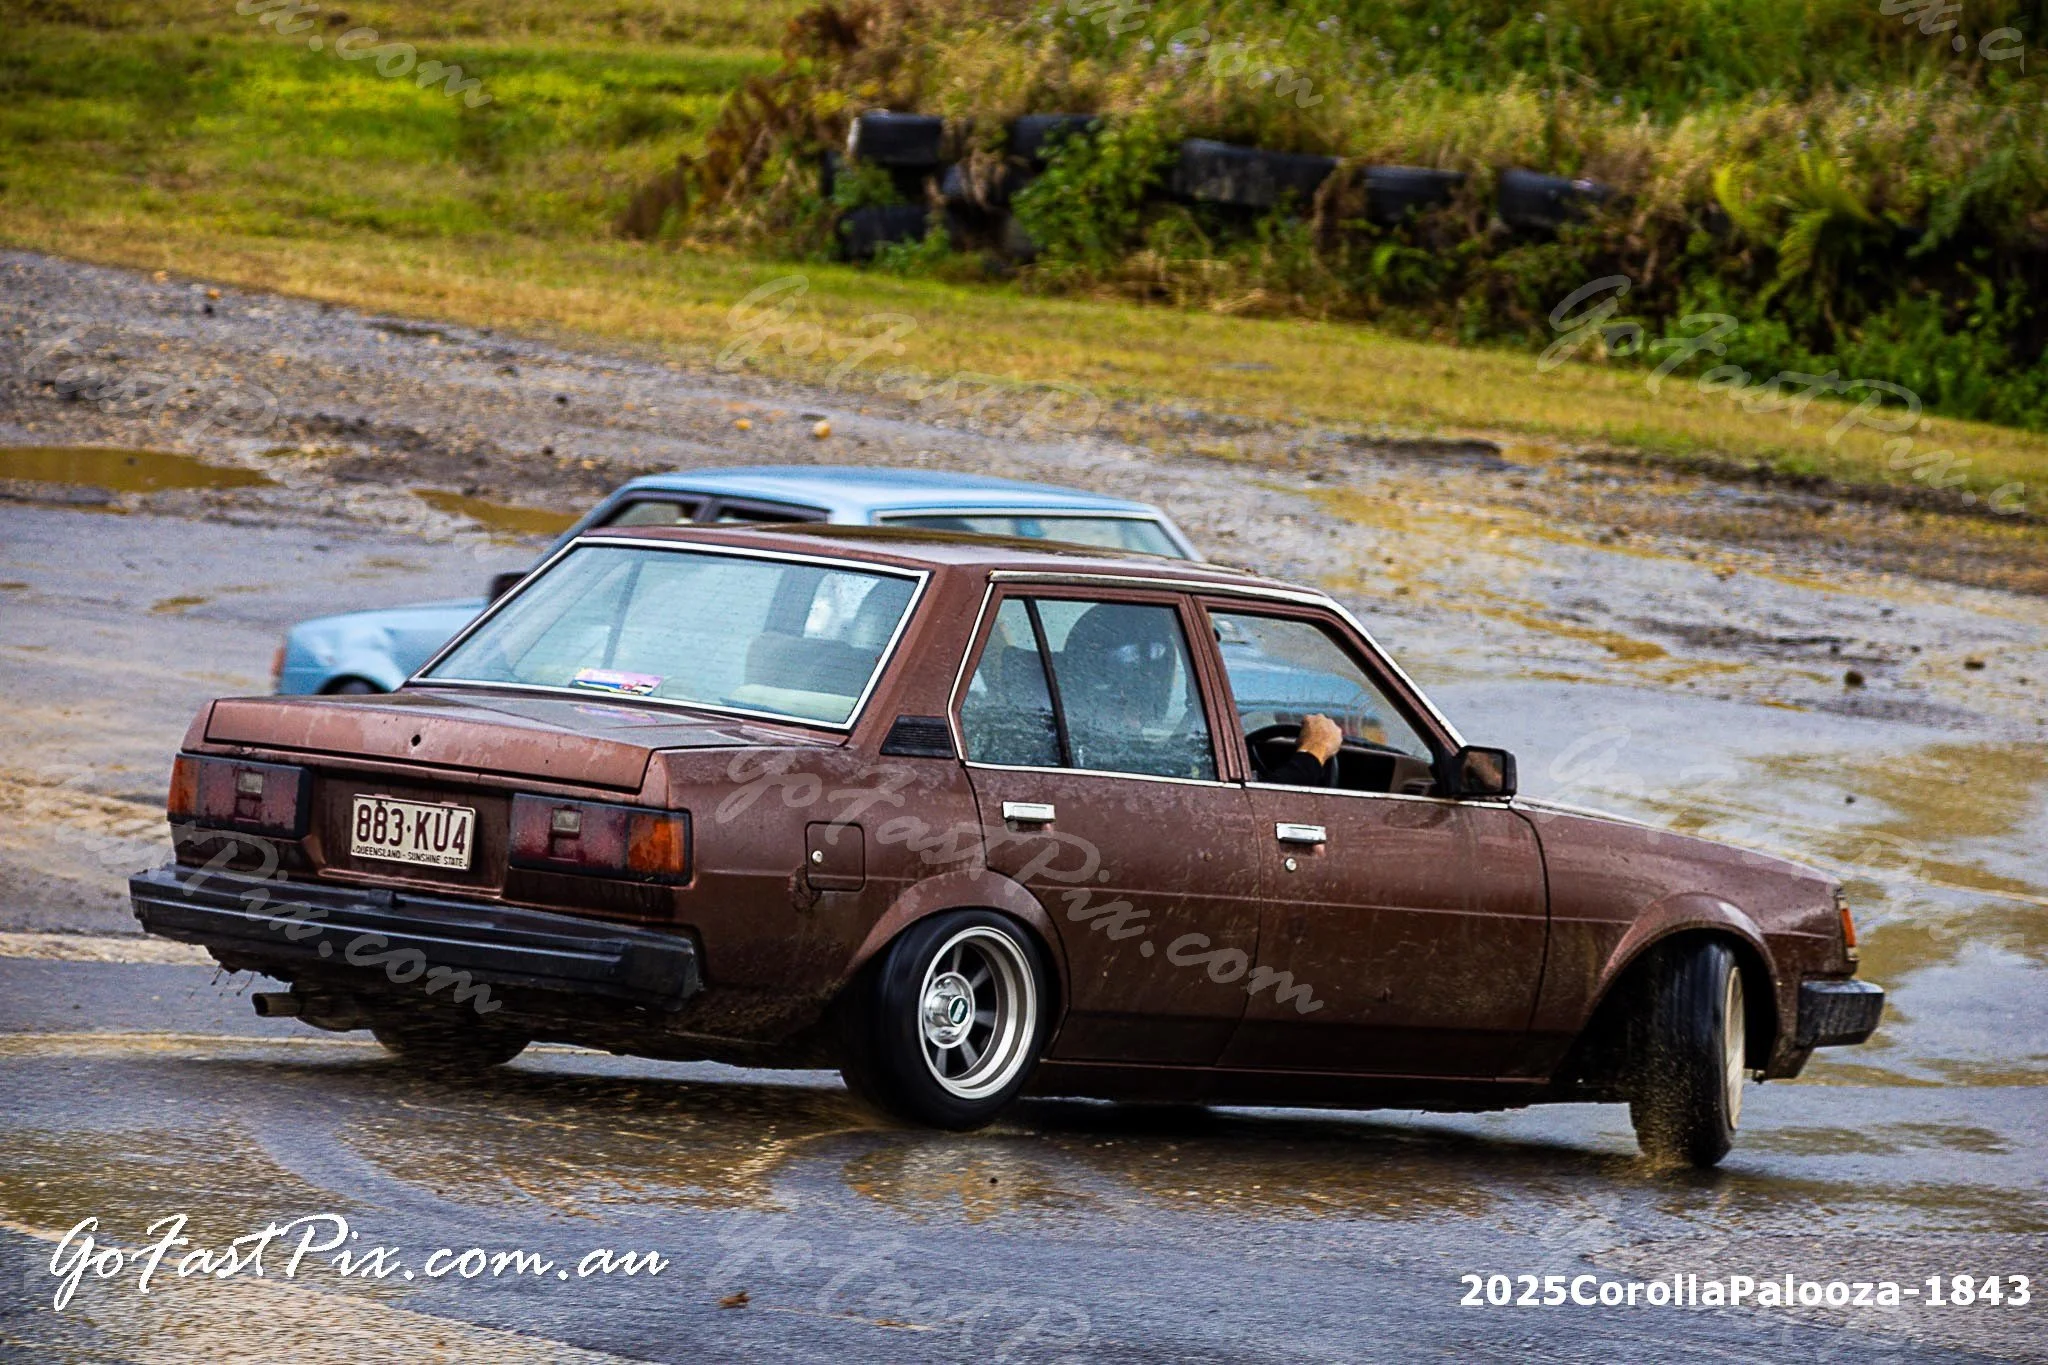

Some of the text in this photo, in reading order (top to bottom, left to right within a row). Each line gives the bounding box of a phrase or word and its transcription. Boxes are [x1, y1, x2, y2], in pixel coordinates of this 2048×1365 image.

[356, 845, 400, 859] QUEENSLAND
[407, 851, 440, 864] SUNSHINE
[444, 857, 463, 867] STATE
